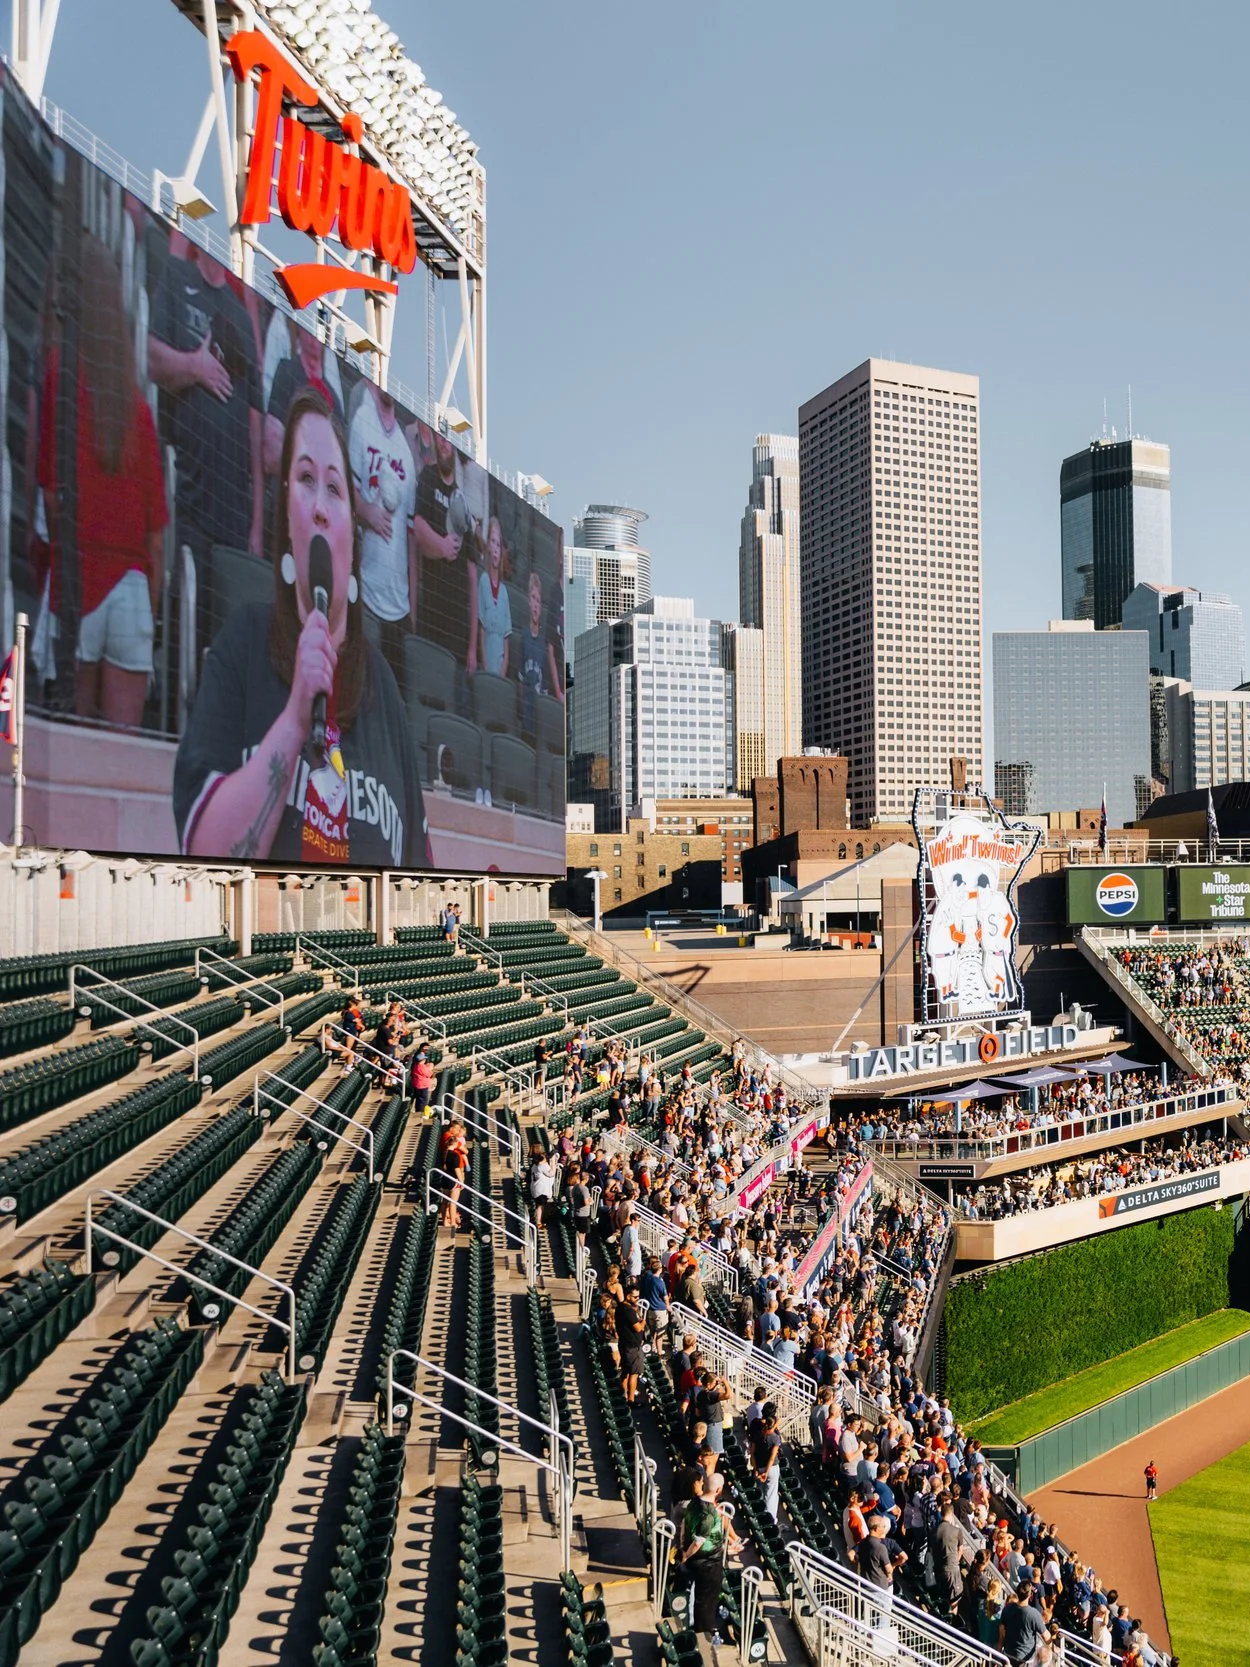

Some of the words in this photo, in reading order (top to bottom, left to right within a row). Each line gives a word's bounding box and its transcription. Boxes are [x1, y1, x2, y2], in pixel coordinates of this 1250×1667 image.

[226, 30, 416, 274] Twins
[1213, 871, 1230, 884] The
[1100, 890, 1135, 899] PEPSI
[1202, 882, 1250, 895] Minnesota
[1223, 894, 1245, 906] Star
[1210, 905, 1245, 917] Tribune
[850, 1038, 977, 1079] TARGET
[1005, 1025, 1079, 1057] FIELD
[1128, 1191, 1160, 1207] DELTA
